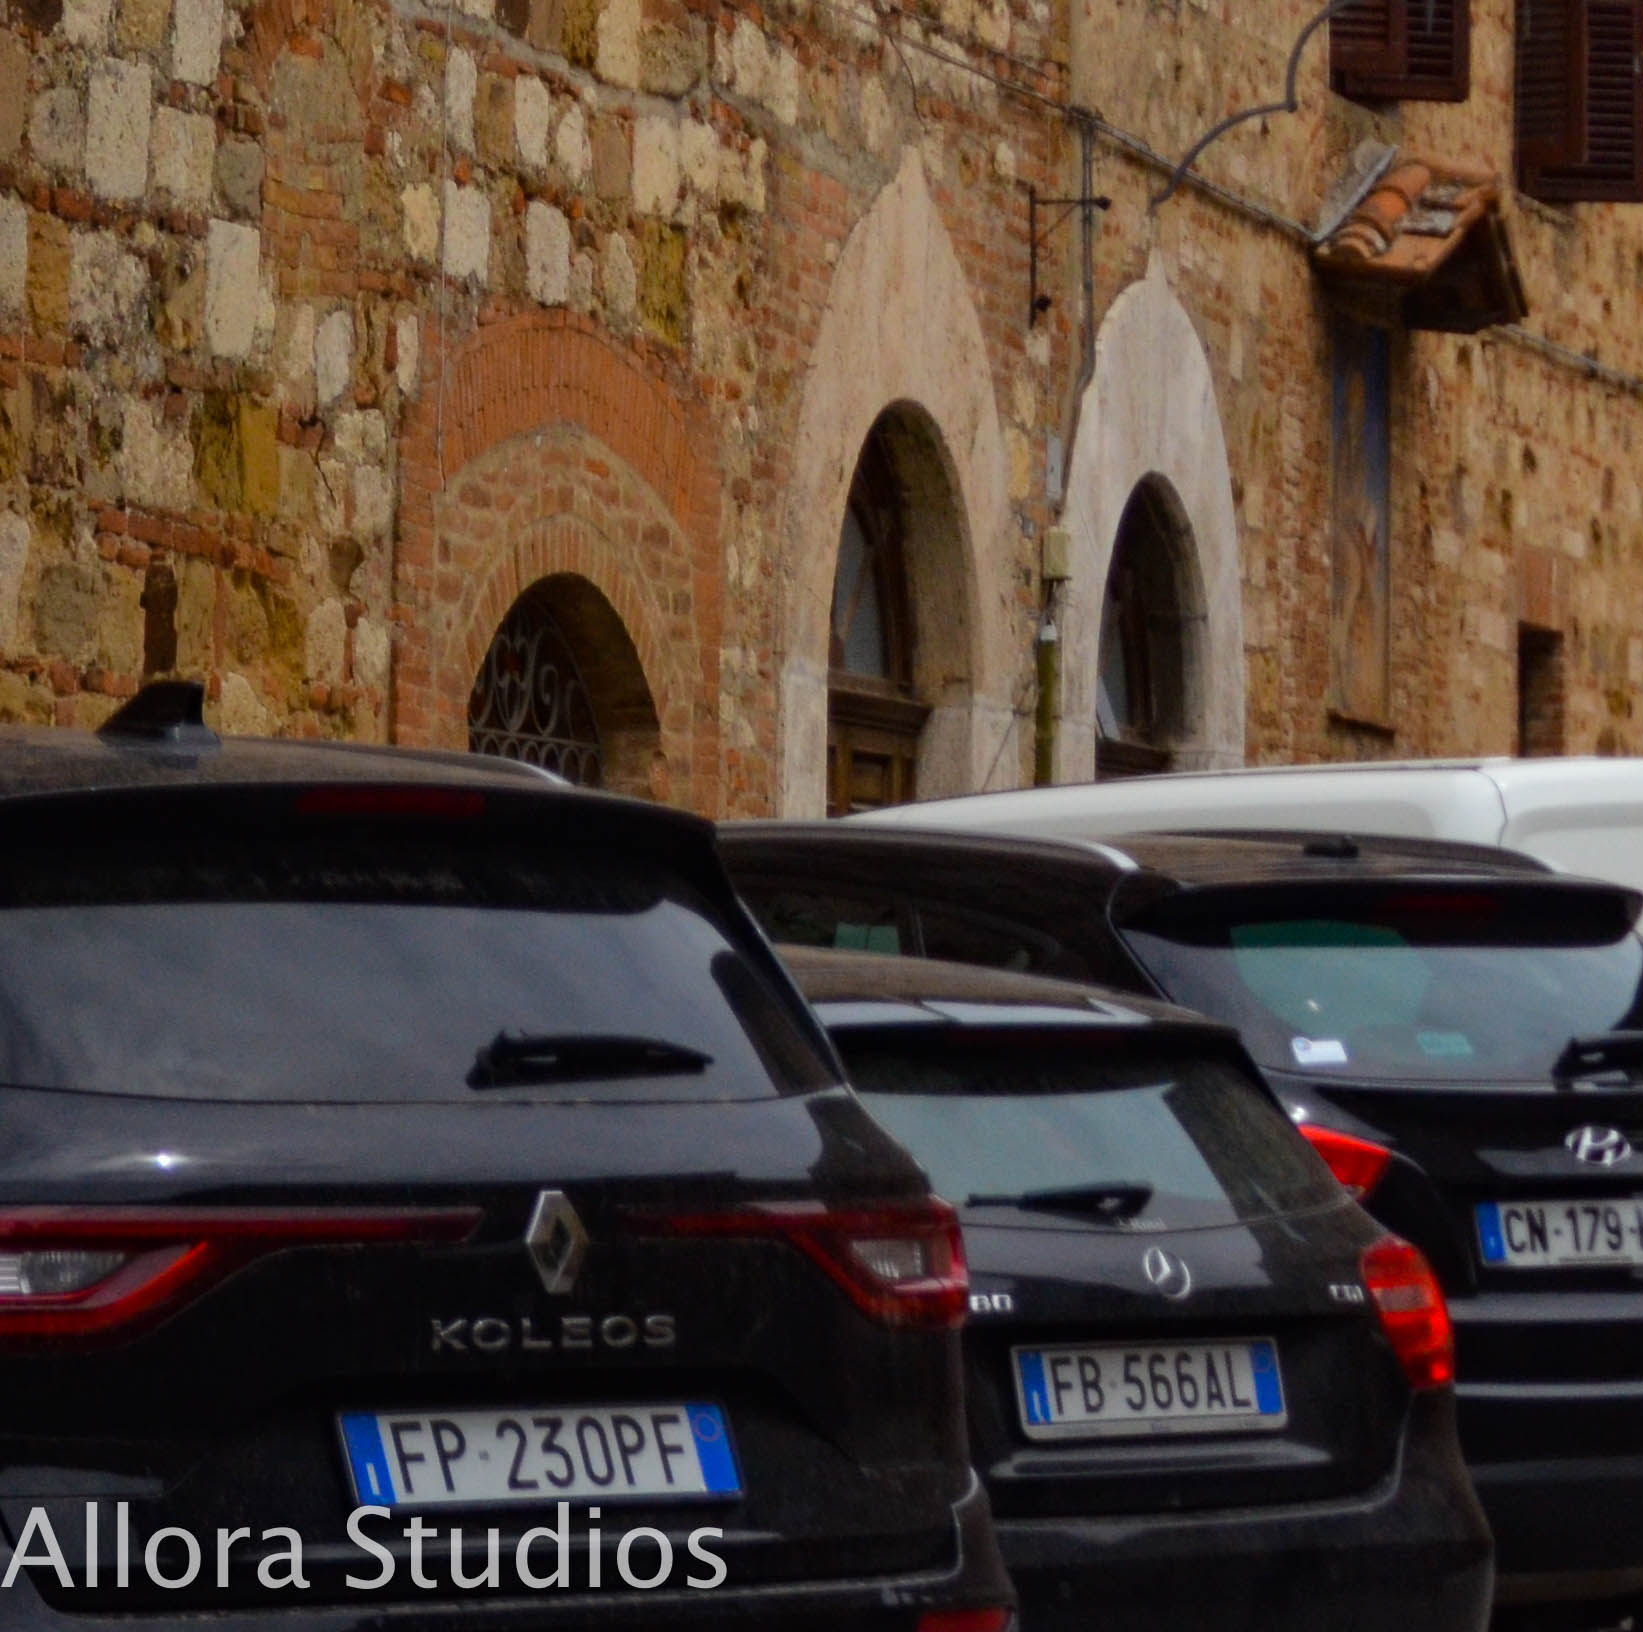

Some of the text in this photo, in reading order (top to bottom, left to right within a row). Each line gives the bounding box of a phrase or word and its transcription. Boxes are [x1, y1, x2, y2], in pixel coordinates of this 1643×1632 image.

[430, 1314, 677, 1352] KOLEOS
[388, 1418, 467, 1495] FP
[495, 1413, 686, 1491] 230PF
